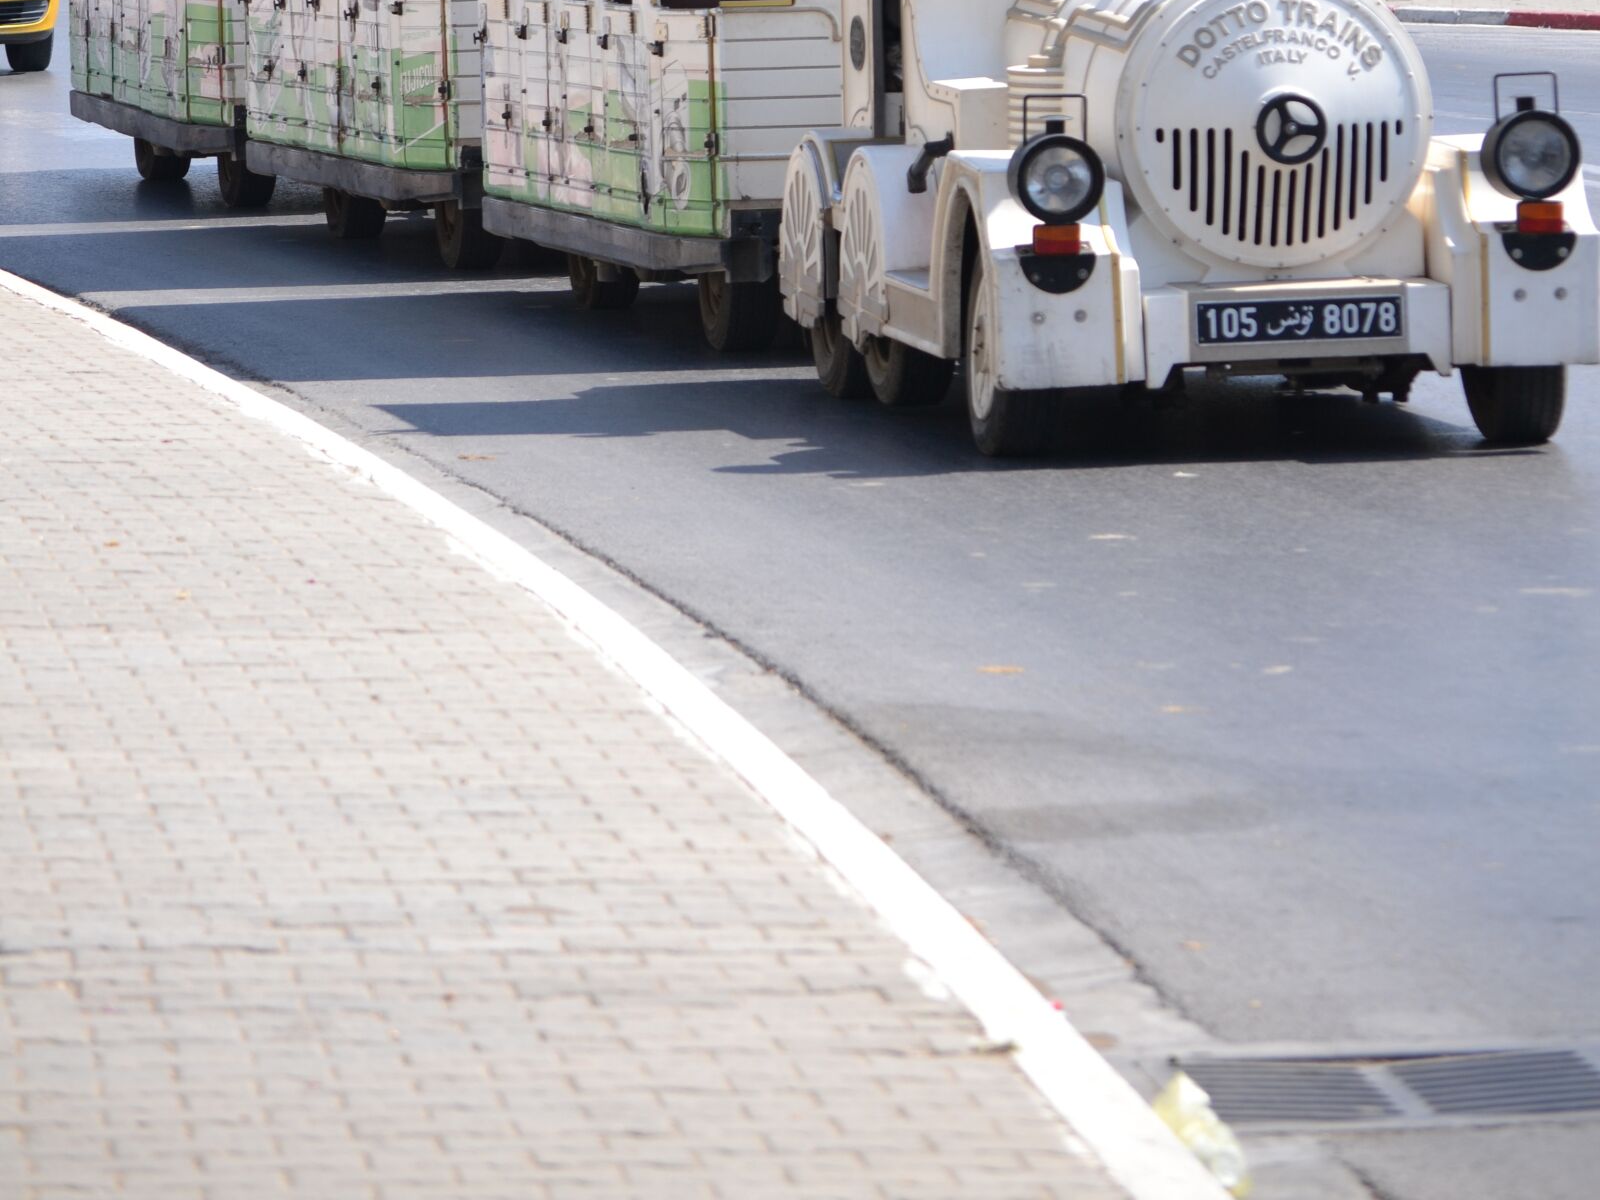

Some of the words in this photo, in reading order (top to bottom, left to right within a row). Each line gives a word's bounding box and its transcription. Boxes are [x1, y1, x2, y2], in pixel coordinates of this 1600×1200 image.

[1176, 0, 1270, 69] DOTTO
[1202, 28, 1341, 79] CASTELFRANCO
[1257, 48, 1308, 65] ITALY
[1206, 306, 1258, 339] 105
[1265, 304, 1314, 336] تونس
[1323, 301, 1396, 335] 8078
